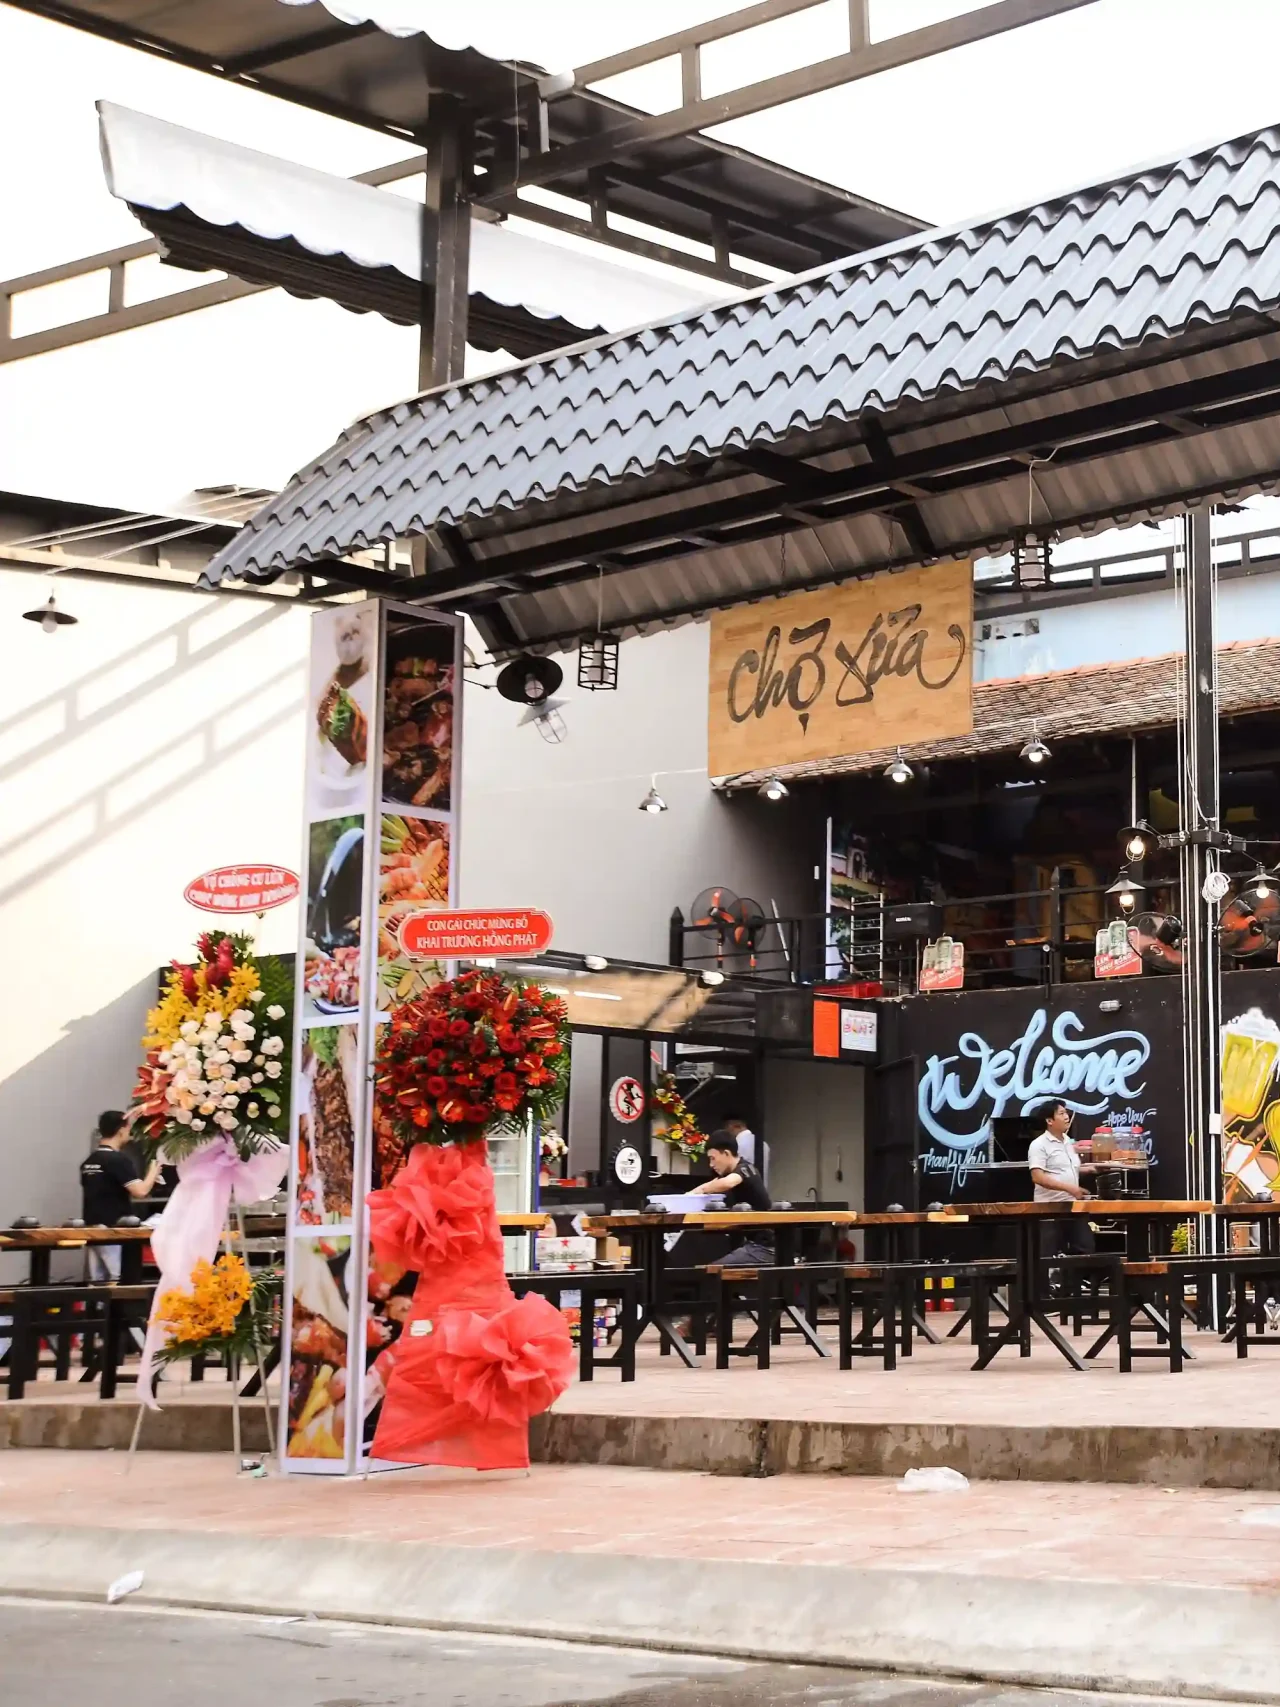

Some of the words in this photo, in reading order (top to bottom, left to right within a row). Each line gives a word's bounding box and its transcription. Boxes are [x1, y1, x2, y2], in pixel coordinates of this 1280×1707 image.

[427, 919, 448, 931] CON
[463, 917, 488, 931] CHÚC
[488, 916, 515, 930] MỪNG
[416, 936, 440, 949] KHAI
[442, 933, 481, 948] TRƯƠNG
[483, 930, 512, 948] HỒNG
[513, 931, 538, 946] PHÁT
[918, 1008, 1151, 1150] Welcome
